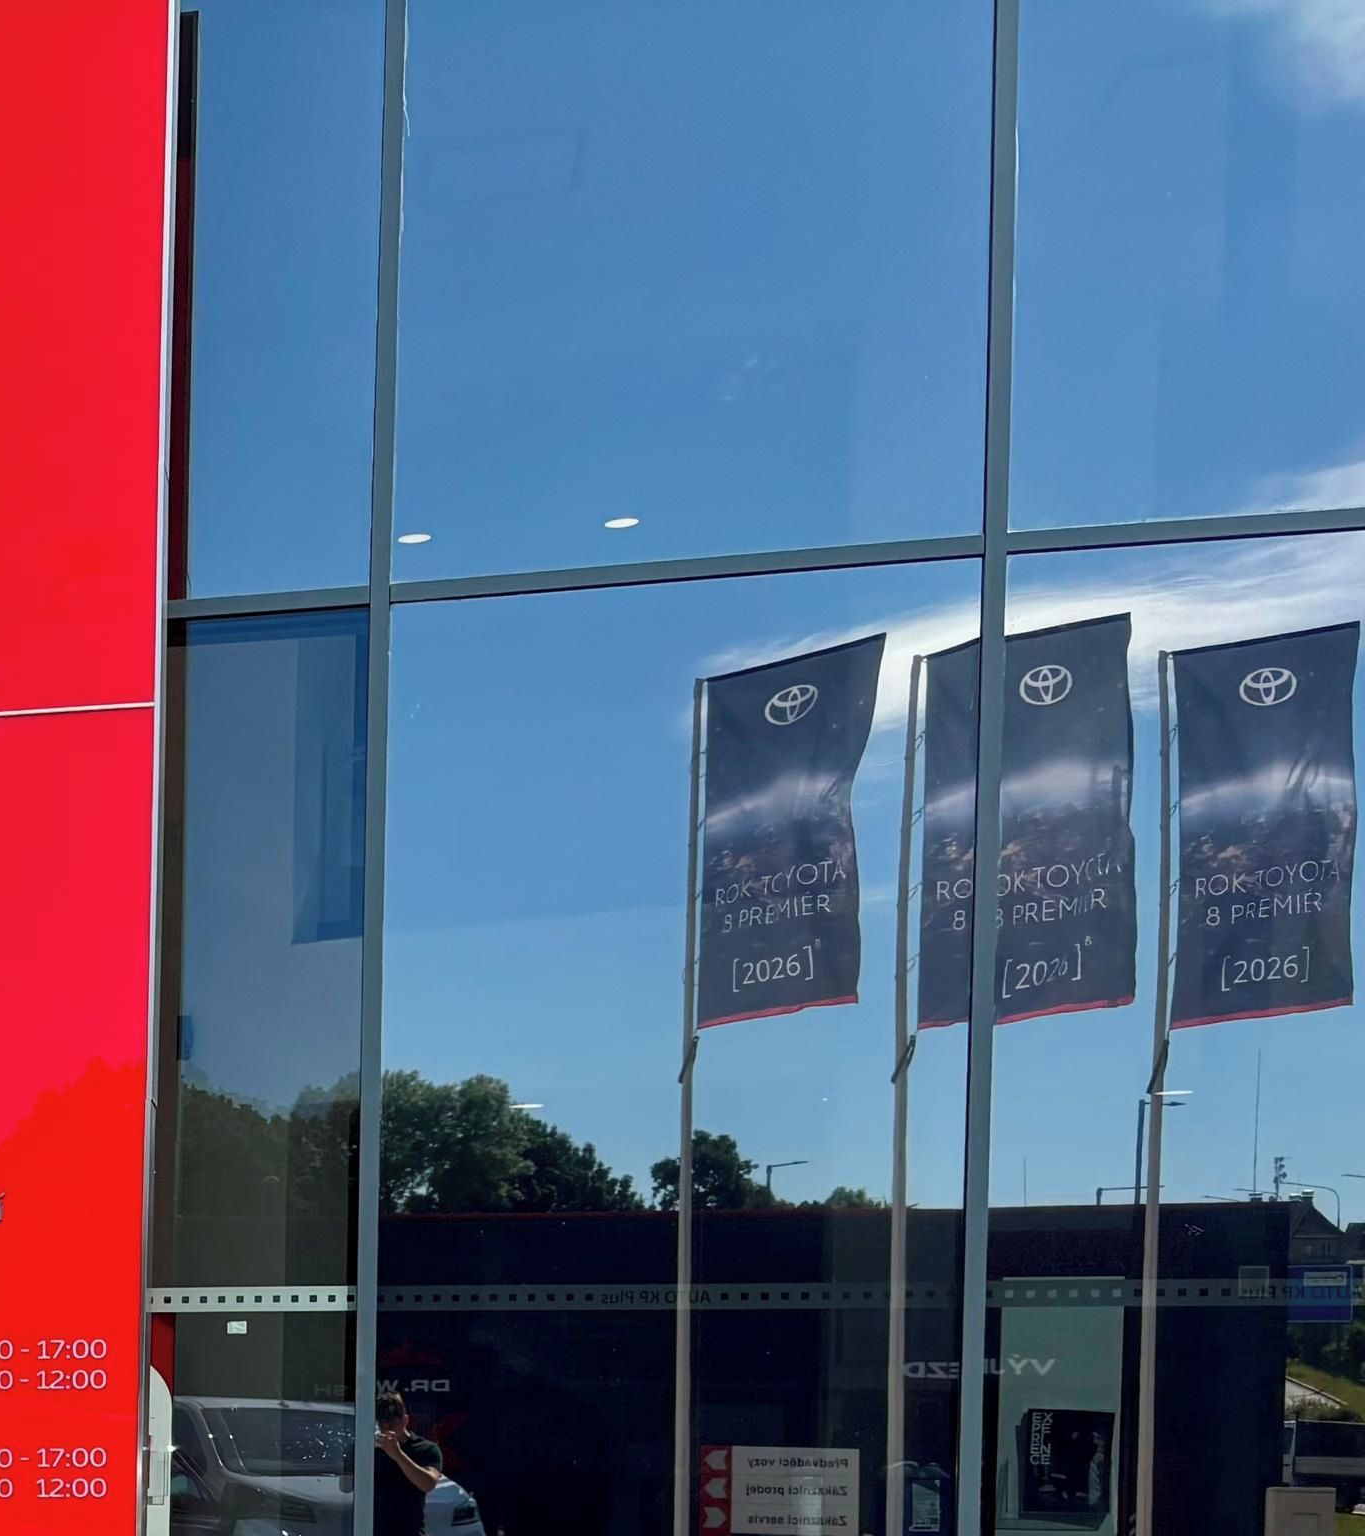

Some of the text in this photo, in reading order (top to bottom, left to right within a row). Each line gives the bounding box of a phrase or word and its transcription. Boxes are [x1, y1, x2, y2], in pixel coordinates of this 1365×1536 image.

[1195, 859, 1340, 899] ROK TOYOTA
[715, 880, 752, 907] ROK
[1205, 888, 1322, 926] 8 PREMIÉR
[721, 914, 733, 933] 8
[732, 945, 814, 993] [2026]
[1221, 946, 1310, 992] [2026]
[36, 1338, 107, 1360] 17:00
[36, 1368, 107, 1390] 12:00
[36, 1447, 107, 1468] 17:00
[36, 1477, 107, 1498] 12:00
